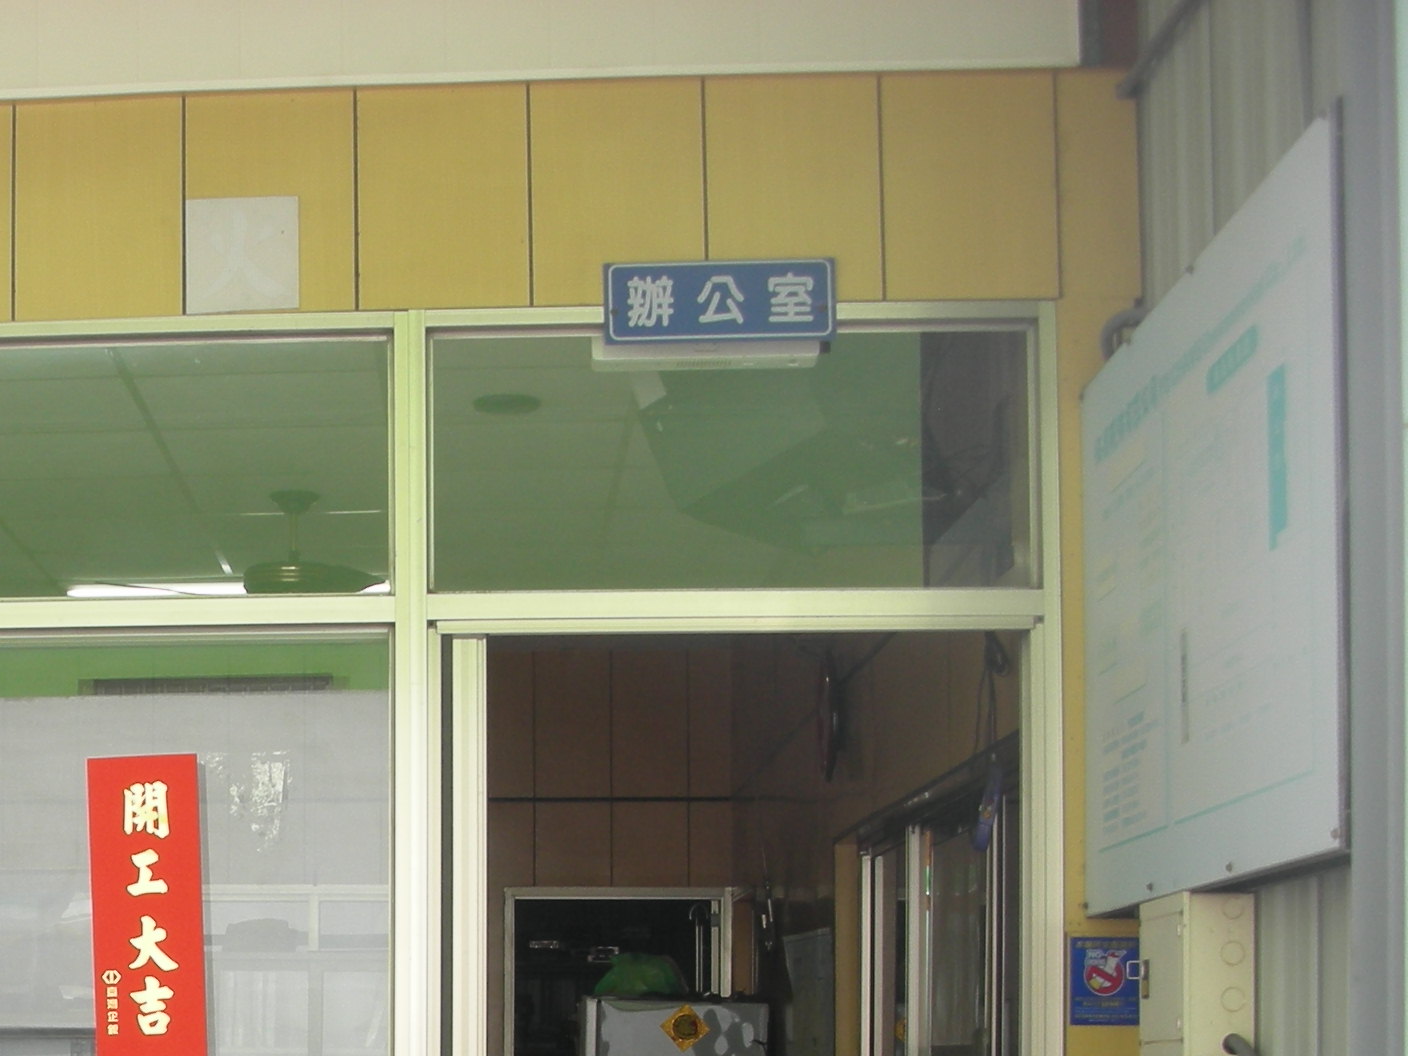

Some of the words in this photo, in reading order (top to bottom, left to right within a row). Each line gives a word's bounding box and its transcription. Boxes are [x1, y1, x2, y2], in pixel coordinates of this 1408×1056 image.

[627, 272, 814, 327] 辦公室
[122, 780, 180, 1036] 開工大吉
